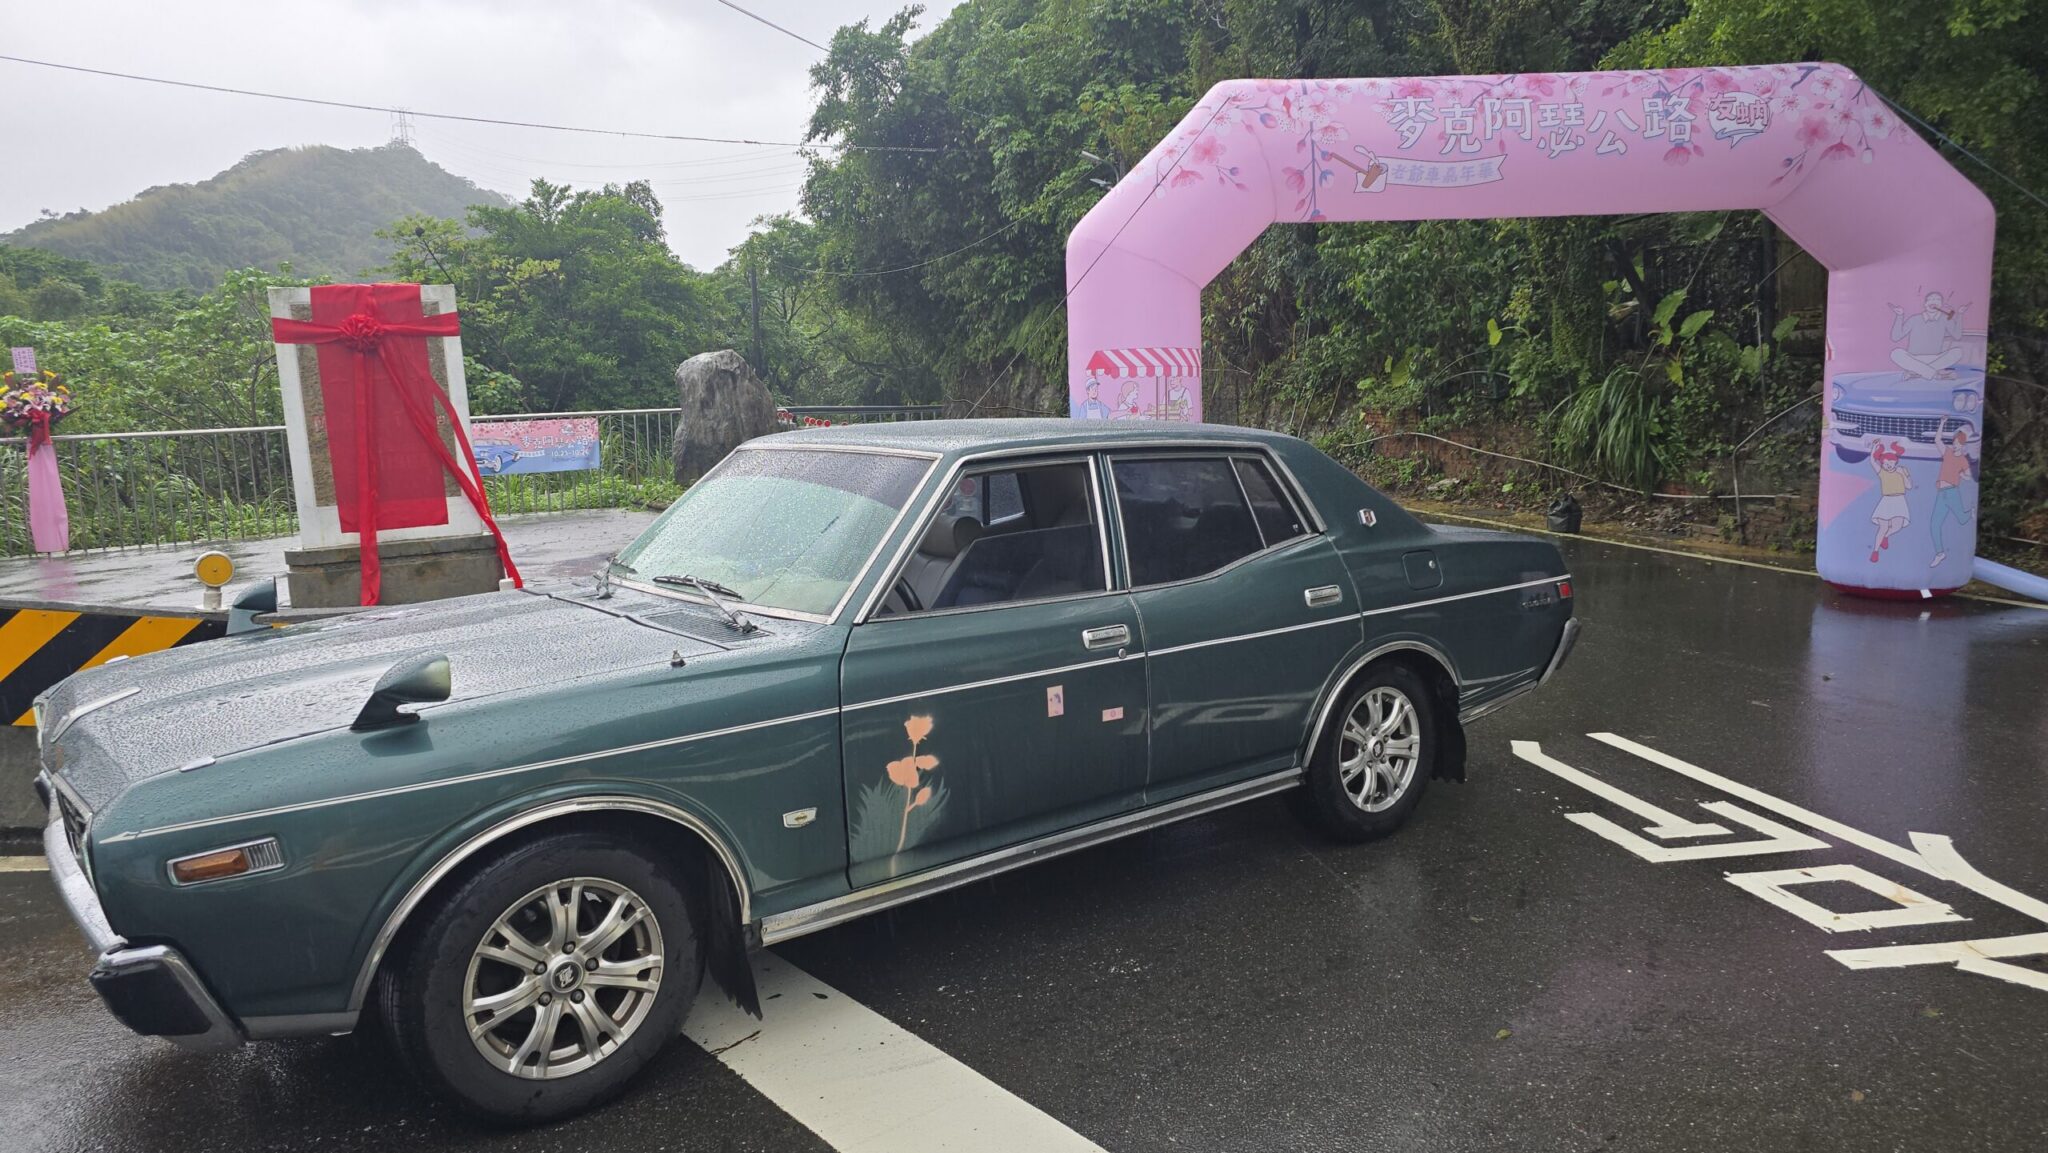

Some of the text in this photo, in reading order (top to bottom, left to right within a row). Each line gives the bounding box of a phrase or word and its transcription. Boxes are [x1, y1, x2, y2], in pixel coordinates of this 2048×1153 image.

[1387, 94, 1698, 161] 麥克阿瑟公路
[1391, 161, 1495, 184] 老爺車嘉年華
